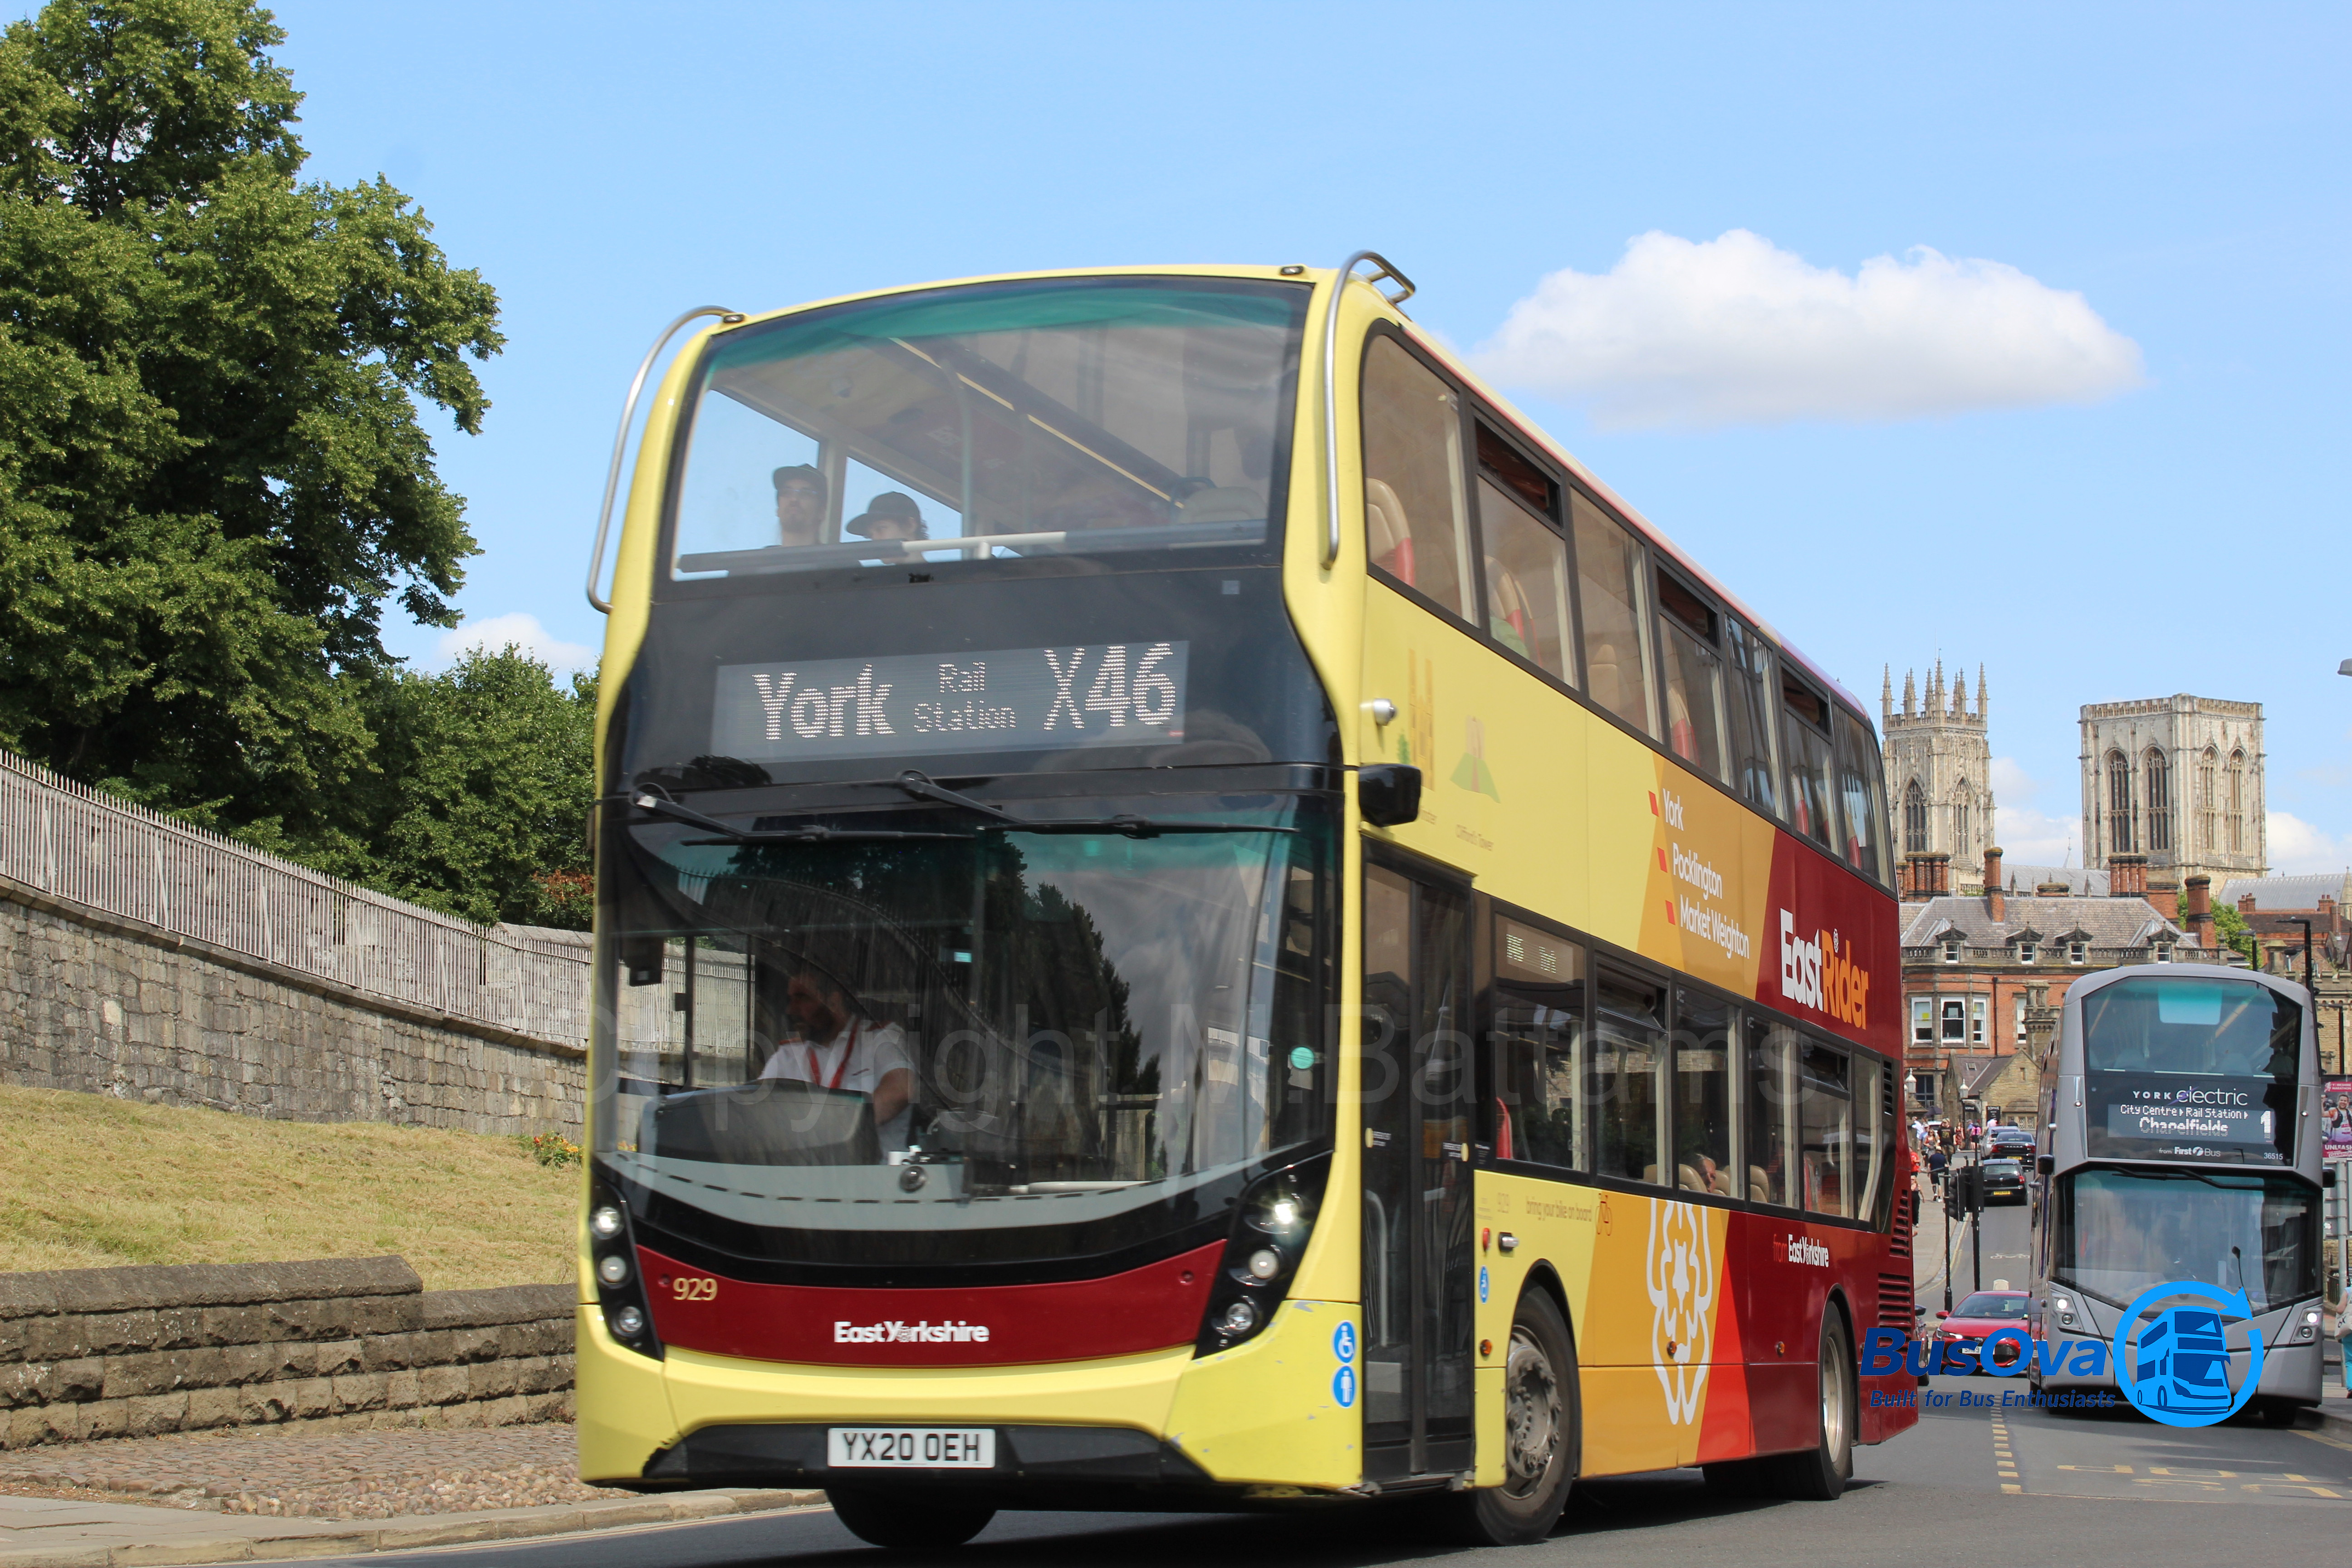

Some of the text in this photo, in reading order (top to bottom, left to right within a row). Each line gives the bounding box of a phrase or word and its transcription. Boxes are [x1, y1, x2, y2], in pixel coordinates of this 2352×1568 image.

[751, 642, 1176, 740] York X46
[938, 662, 986, 693] Rail
[913, 700, 1017, 733] Station
[1662, 788, 1684, 831] York
[1672, 842, 1723, 901] Pocklington
[1680, 894, 1750, 960] Market Weighton
[2132, 1085, 2248, 1106] YORK electric
[2120, 1104, 2243, 1119] City Centre Rail Station
[2259, 1110, 2271, 1139] 1
[2174, 1147, 2192, 1156] First
[2204, 1148, 2221, 1157] Bus
[2263, 1152, 2283, 1160] 36515
[1773, 1233, 1788, 1264] from
[673, 1277, 718, 1301] 929
[843, 1433, 980, 1461] YX20 OEH
